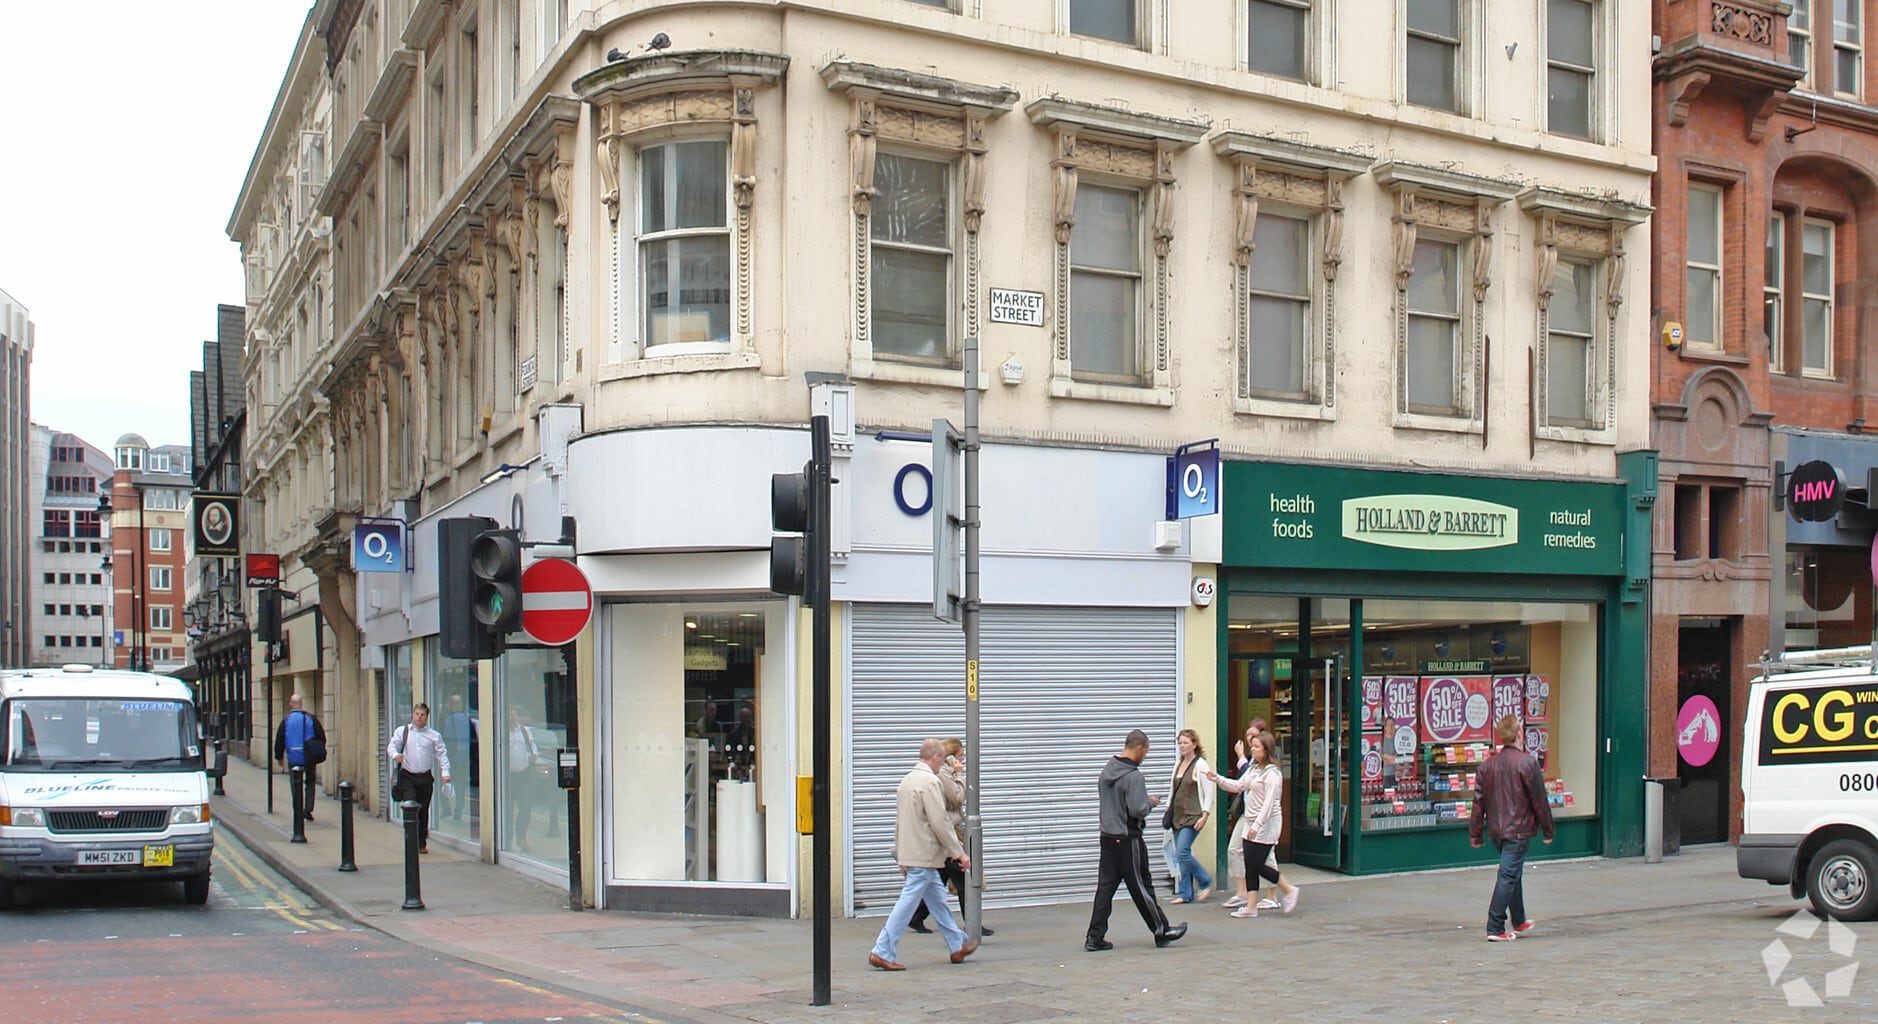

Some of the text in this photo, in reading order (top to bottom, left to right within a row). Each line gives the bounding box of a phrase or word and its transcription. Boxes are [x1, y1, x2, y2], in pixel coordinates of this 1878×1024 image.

[993, 291, 1041, 308] MARKET
[994, 306, 1036, 321] STREET
[1794, 479, 1836, 503] HMV
[1270, 493, 1315, 514] health
[1356, 507, 1507, 538] HOLLAND & BARRETT
[1550, 509, 1591, 526] natural
[1272, 519, 1313, 539] foods
[1544, 531, 1596, 549] remedies
[1427, 661, 1453, 672] HOLLAND
[1460, 661, 1484, 671] BARRETT
[1389, 681, 1416, 704] 50%
[1431, 684, 1462, 711] 50%
[1494, 684, 1520, 707] 50%
[1389, 702, 1416, 719] SALE
[1432, 708, 1462, 729] SALE
[1772, 689, 1855, 744] CG
[24, 784, 117, 794] BLUELINE
[1840, 773, 1878, 791] 080
[85, 852, 110, 863] MM51
[112, 851, 134, 863] ZKD
